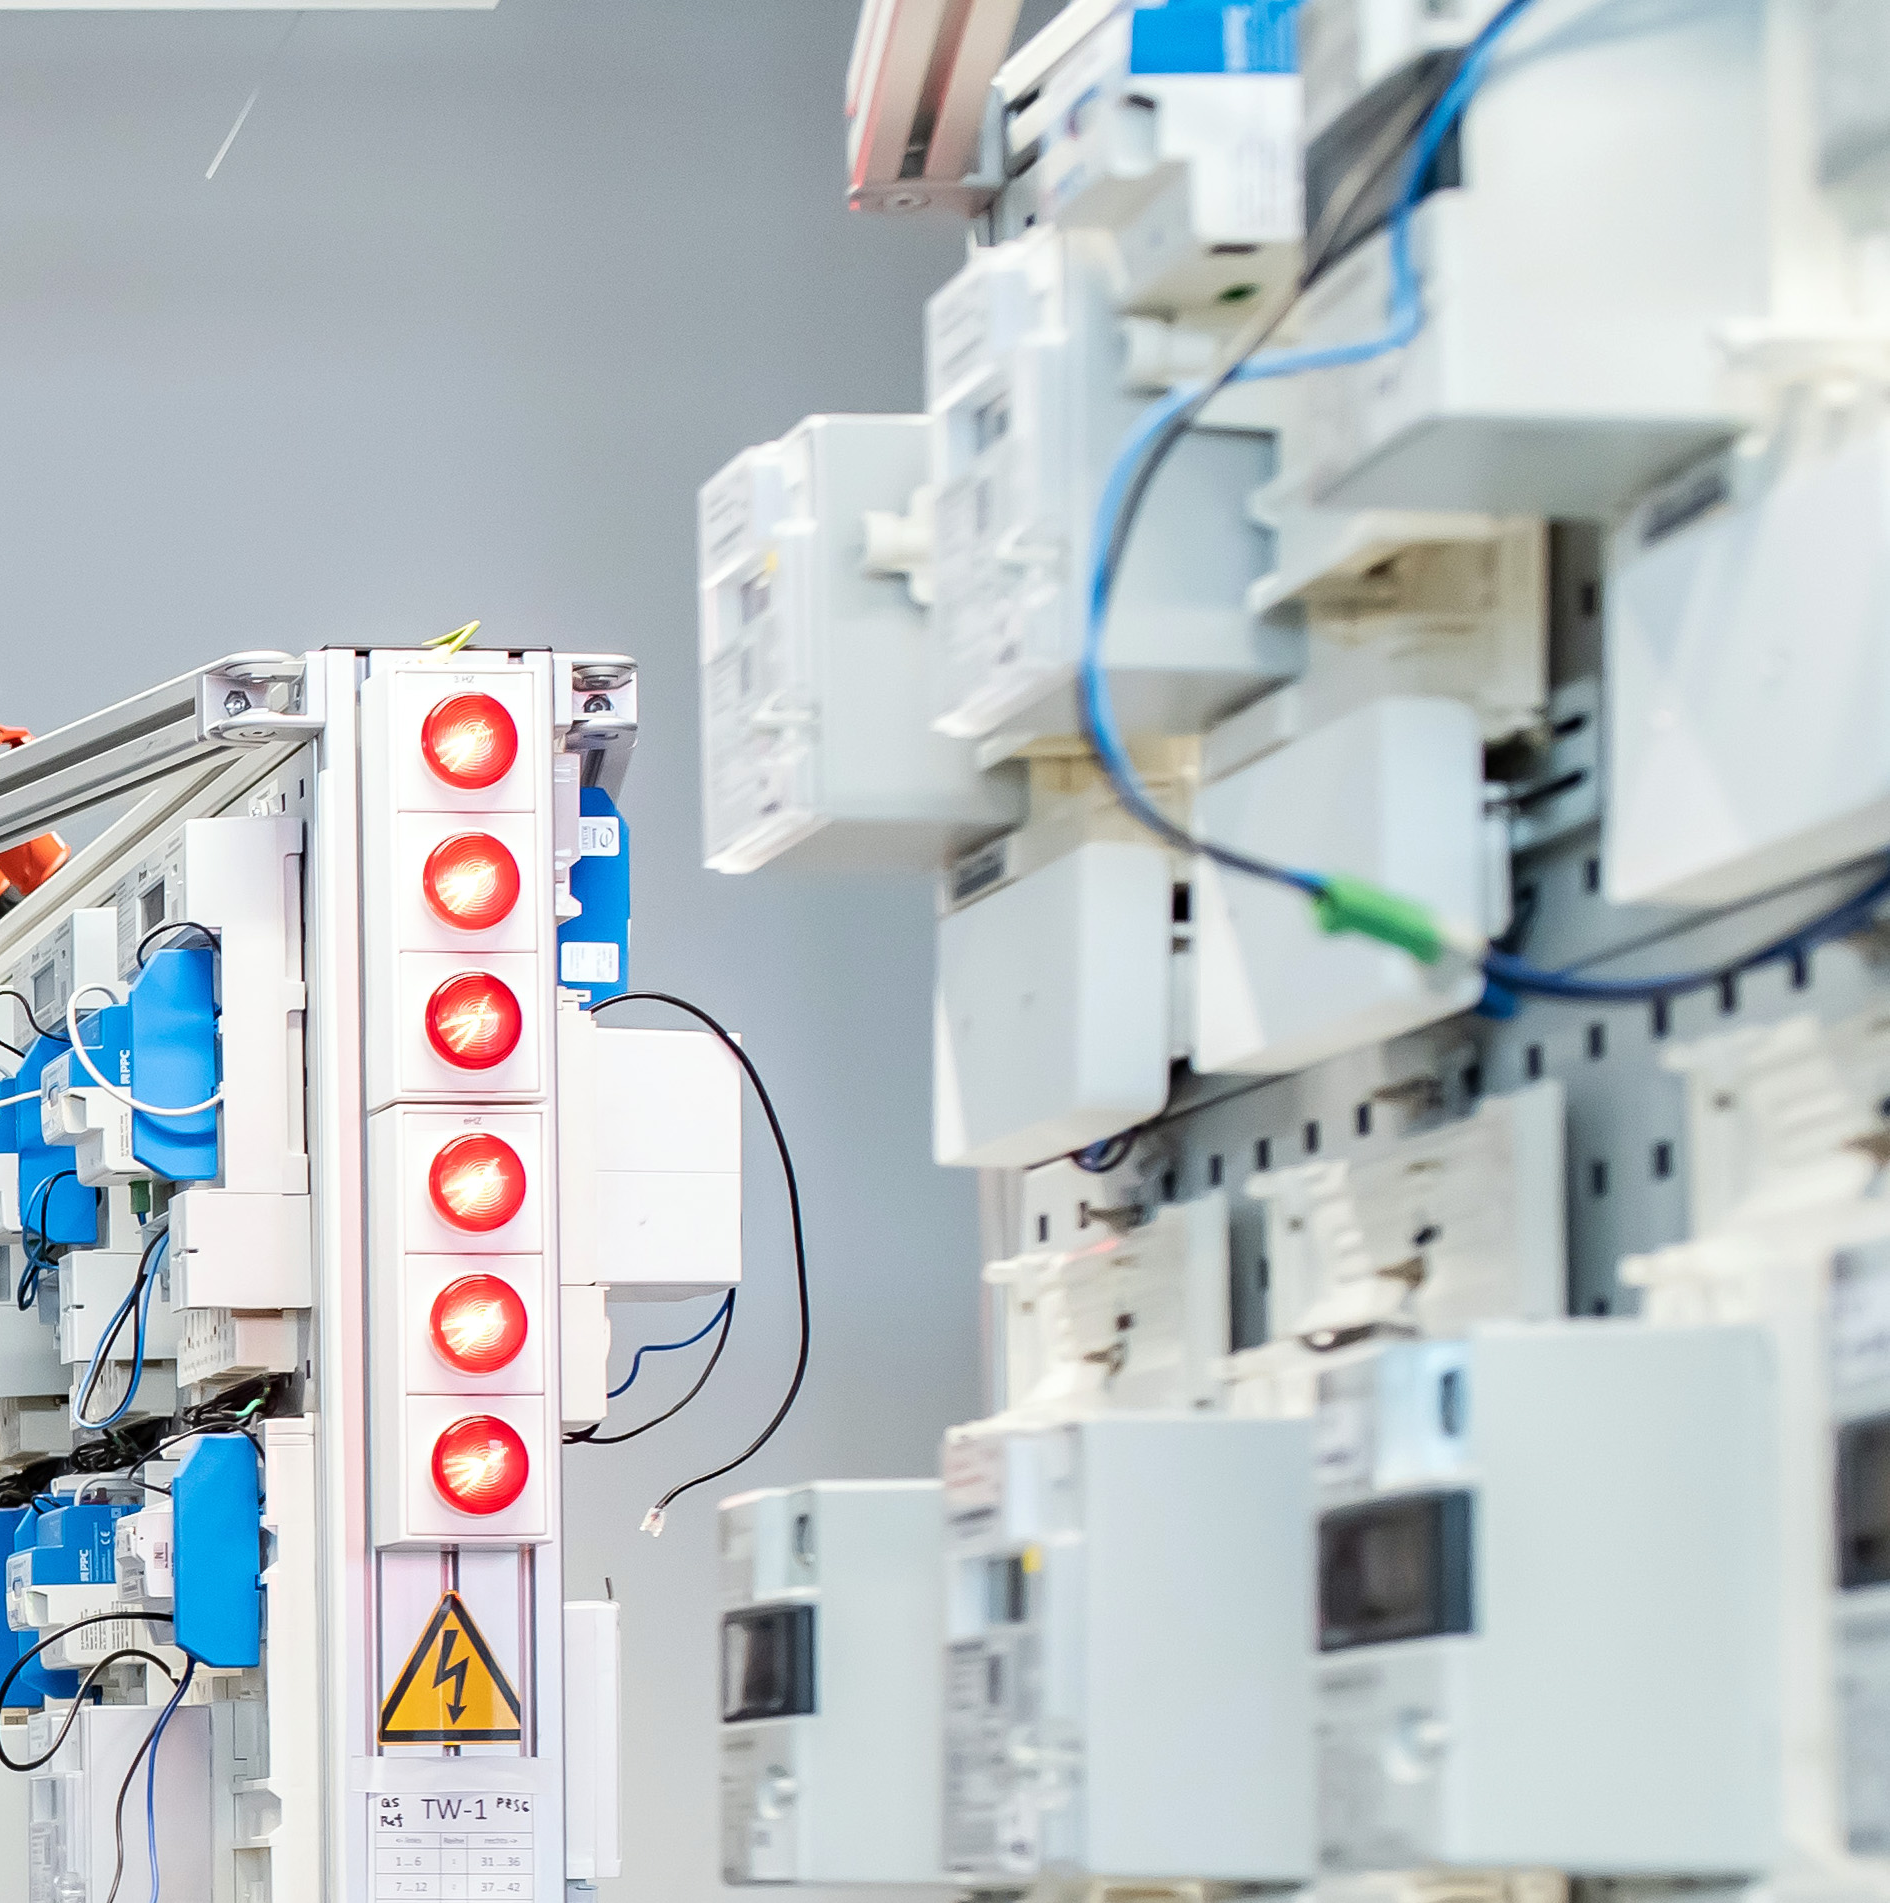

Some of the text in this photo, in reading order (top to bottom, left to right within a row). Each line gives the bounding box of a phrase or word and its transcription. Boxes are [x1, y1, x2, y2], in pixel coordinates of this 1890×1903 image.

[120, 1049, 131, 1073] PPC
[79, 1549, 89, 1572] PPC
[421, 1799, 487, 1819] TW-1
